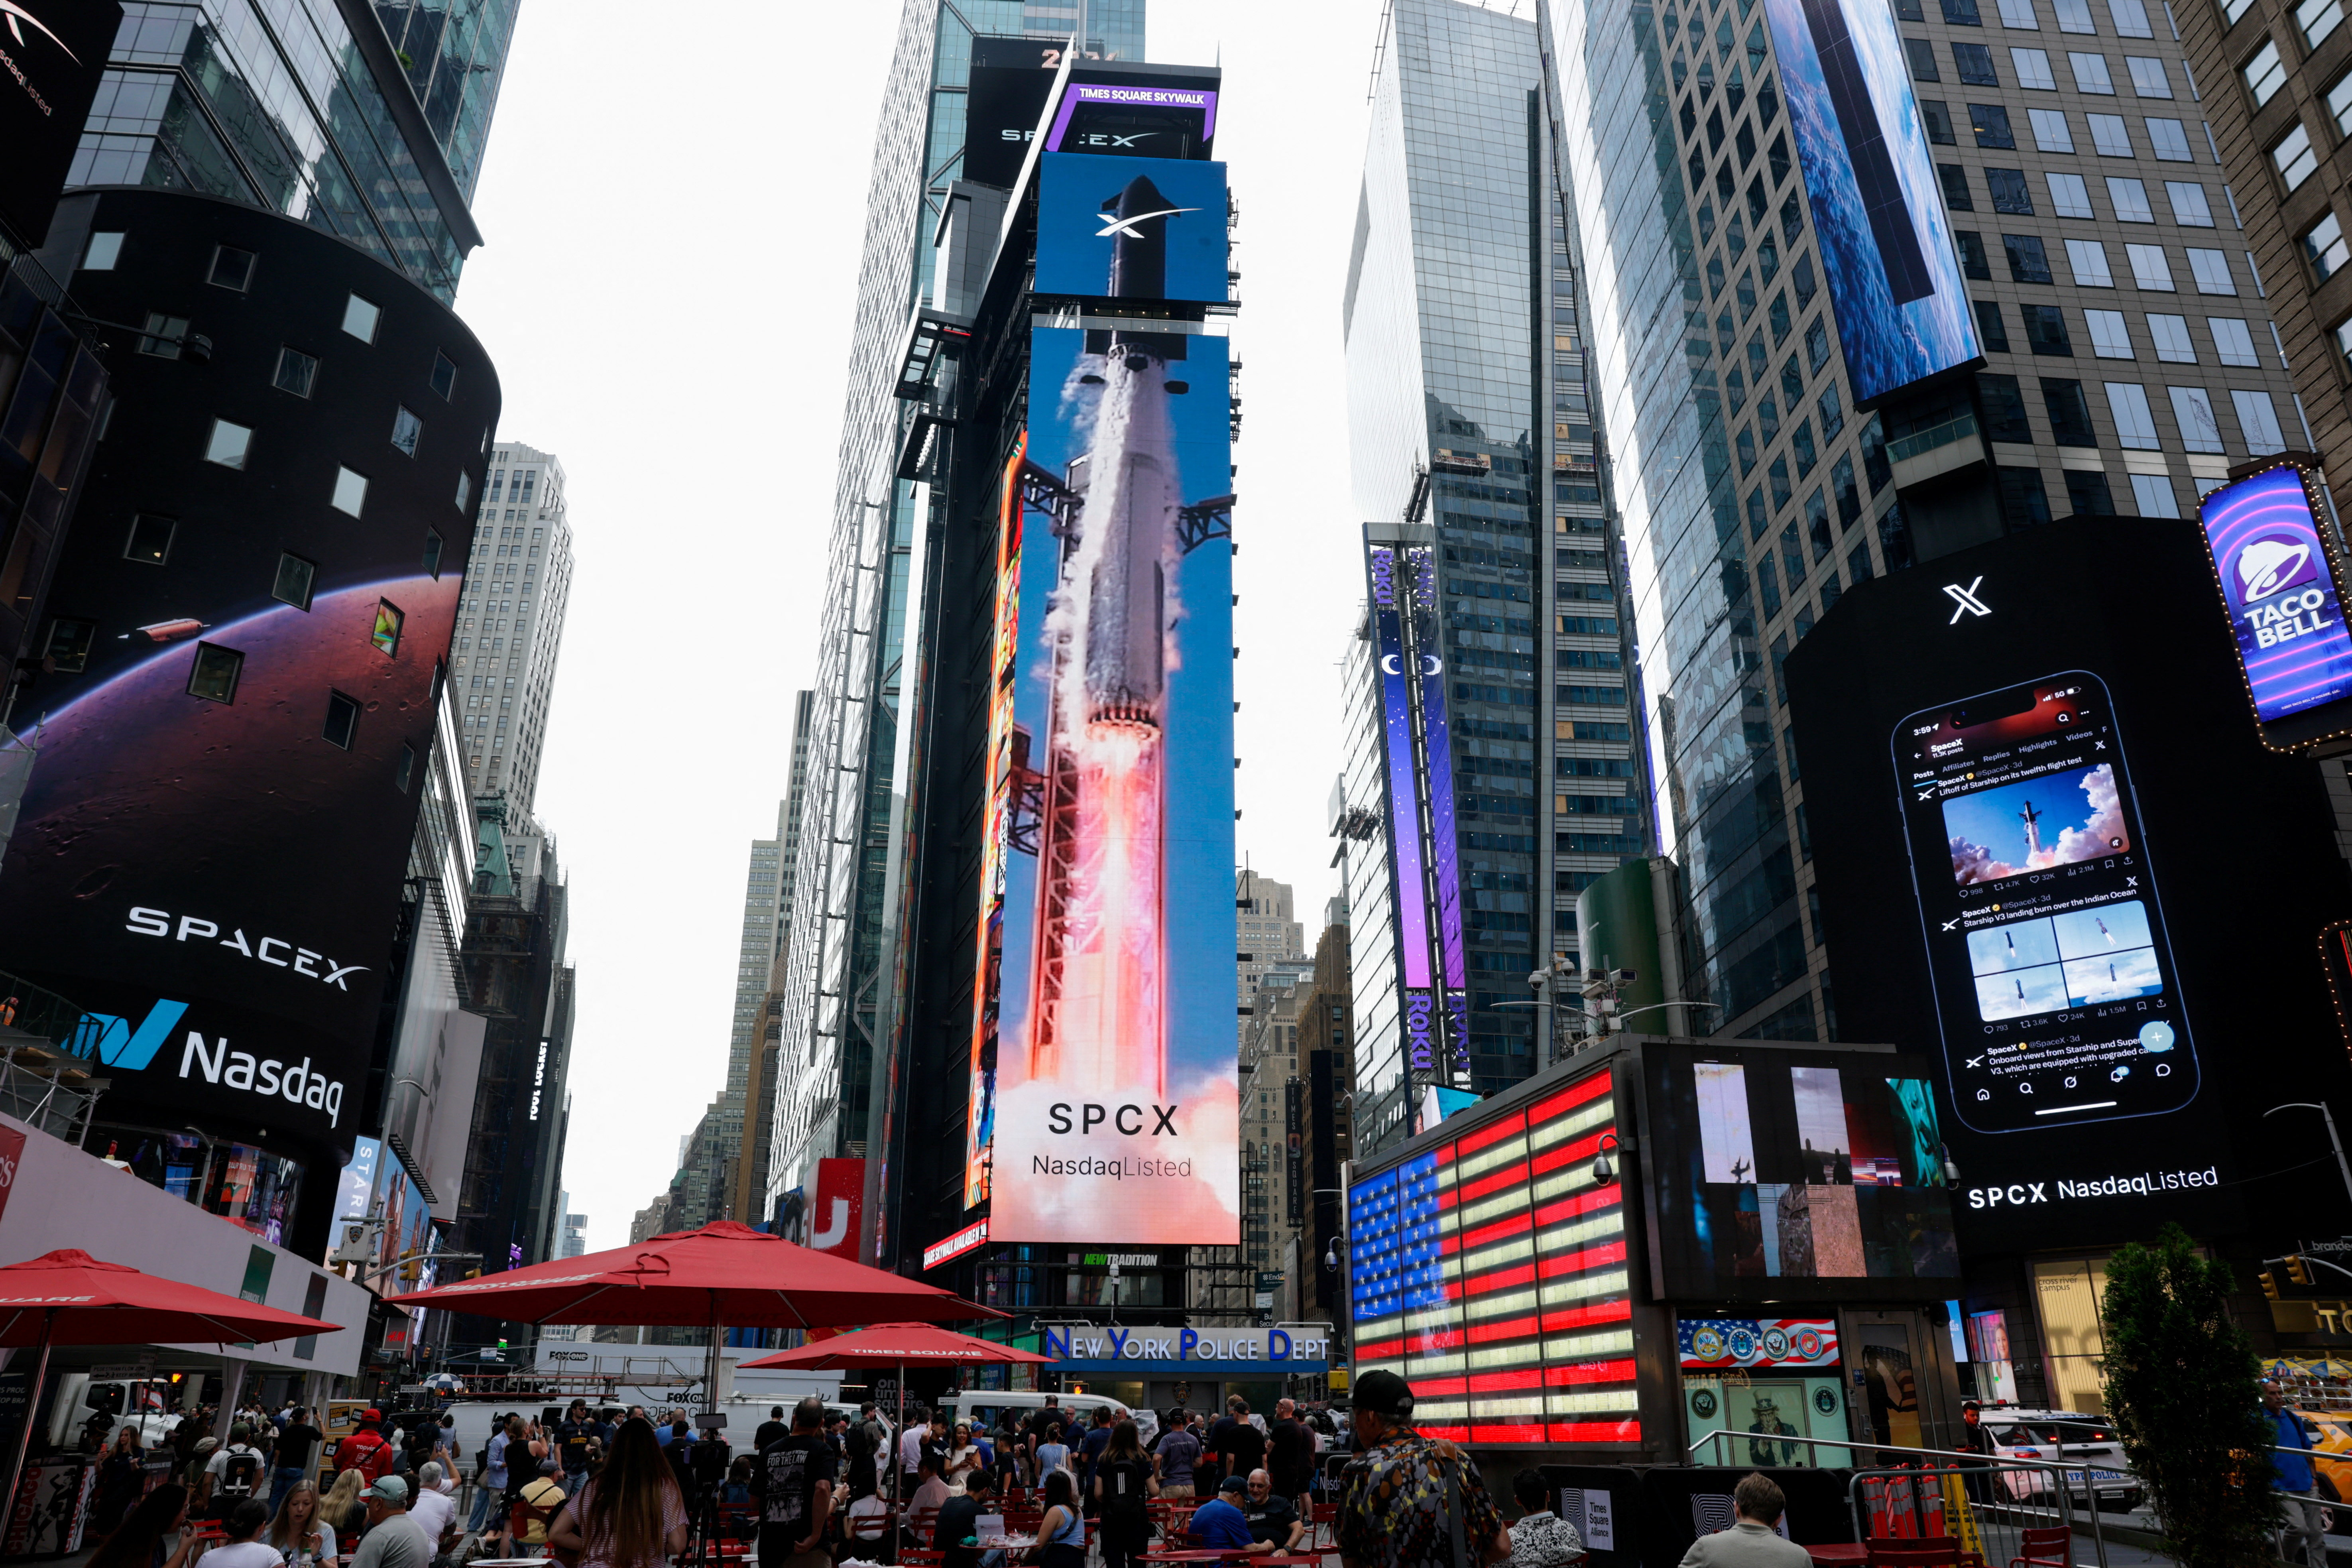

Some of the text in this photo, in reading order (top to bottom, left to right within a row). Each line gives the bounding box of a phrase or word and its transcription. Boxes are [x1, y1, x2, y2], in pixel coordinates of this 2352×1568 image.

[1080, 88, 1204, 104] TIMES SQUARE SKYWALK
[1001, 129, 1160, 147] SPEX
[2244, 588, 2324, 629] TACO
[2255, 610, 2332, 649] BELL
[1913, 726, 1931, 736] 3:59
[2066, 730, 2093, 742] Videos
[1931, 738, 1963, 753] SpaceX
[1932, 746, 1964, 758] 11.3K posts
[2018, 739, 2057, 754] Highlights
[1983, 751, 2010, 763] Replies
[1942, 759, 1975, 773] Affiliates
[1913, 769, 1934, 780] Posts
[1937, 775, 1966, 788] SpaceX
[1975, 764, 2010, 778] @SpaceX
[1939, 785, 1960, 797] Liftoff
[1970, 776, 1999, 790] Starship
[2010, 771, 2020, 780] its
[2021, 765, 2047, 777] twelfth
[2047, 760, 2067, 773] flight
[2067, 756, 2083, 766] test
[2041, 872, 2055, 881] 32K
[2078, 865, 2094, 874] 2.1M
[1970, 887, 1984, 896] 998
[2005, 880, 2020, 889] 4.7K
[1962, 906, 1991, 919] SpaceX
[2002, 897, 2037, 909] @SpaceX
[1964, 888, 2137, 928] Starship V3 landing burn over the Indian Ocean
[125, 906, 373, 992] SPACEX
[2070, 1012, 2085, 1020] 24K
[2109, 1005, 2126, 1014] 1.5M
[2032, 1018, 2048, 1026] 3.6K
[1987, 1034, 2080, 1056] SpaceX @SpaceX 3d
[1989, 1037, 2141, 1066] Onboard views from Starship and Super
[1990, 1066, 2004, 1076] V3,
[2005, 1063, 2028, 1073] which
[2042, 1056, 2079, 1070] equipped
[2080, 1053, 2097, 1062] with
[2098, 1047, 2137, 1060] upgraded
[178, 1031, 344, 1129] Nasdaq
[1048, 1102, 1178, 1137] SPCX
[1032, 1155, 1192, 1180] NasdaqListed
[1969, 1182, 2048, 1208] SPCX
[935, 1239, 954, 1261] SKYWALK
[953, 1228, 976, 1252] AVAILABLE
[431, 1272, 604, 1293] TIMES SQUARE
[2039, 1284, 2071, 1292] campus
[1046, 1327, 1330, 1360] NEW YORK POLICE DEPT
[550, 1351, 588, 1361] FOX ONE
[980, 1369, 999, 1380] Times Square
[667, 1393, 689, 1404] FOX
[767, 1454, 808, 1467] FOR THE LAW
[2092, 1471, 2121, 1479] POLICE
[5, 1467, 42, 1555] CHICAGO
[64, 1466, 88, 1553] CHICAGO
[1589, 1502, 1607, 1513] Times
[1589, 1513, 1609, 1527] Square
[1591, 1527, 1609, 1537] Alliance
